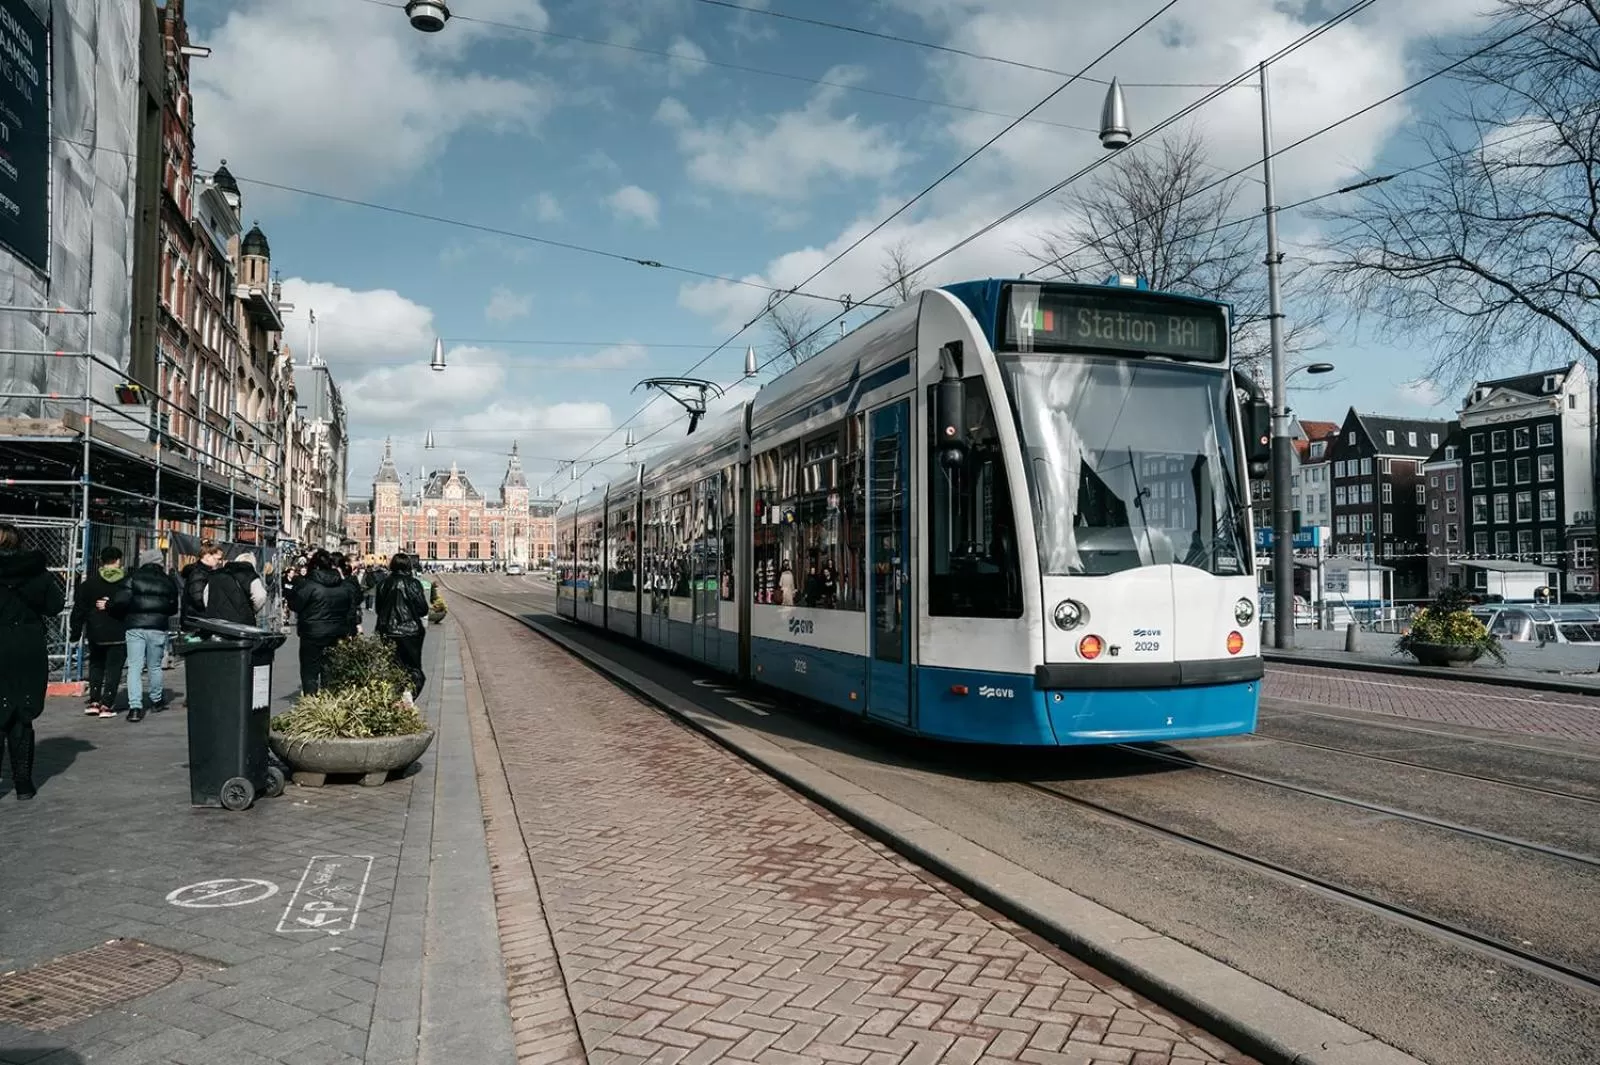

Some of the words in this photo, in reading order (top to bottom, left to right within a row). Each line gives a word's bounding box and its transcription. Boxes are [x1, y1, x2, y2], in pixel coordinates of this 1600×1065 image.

[1020, 301, 1035, 337] 4
[1077, 308, 1157, 344] Station
[1167, 315, 1200, 348] RAI
[801, 619, 814, 634] GVB
[1135, 641, 1160, 651] 2029
[995, 687, 1014, 698] GVB
